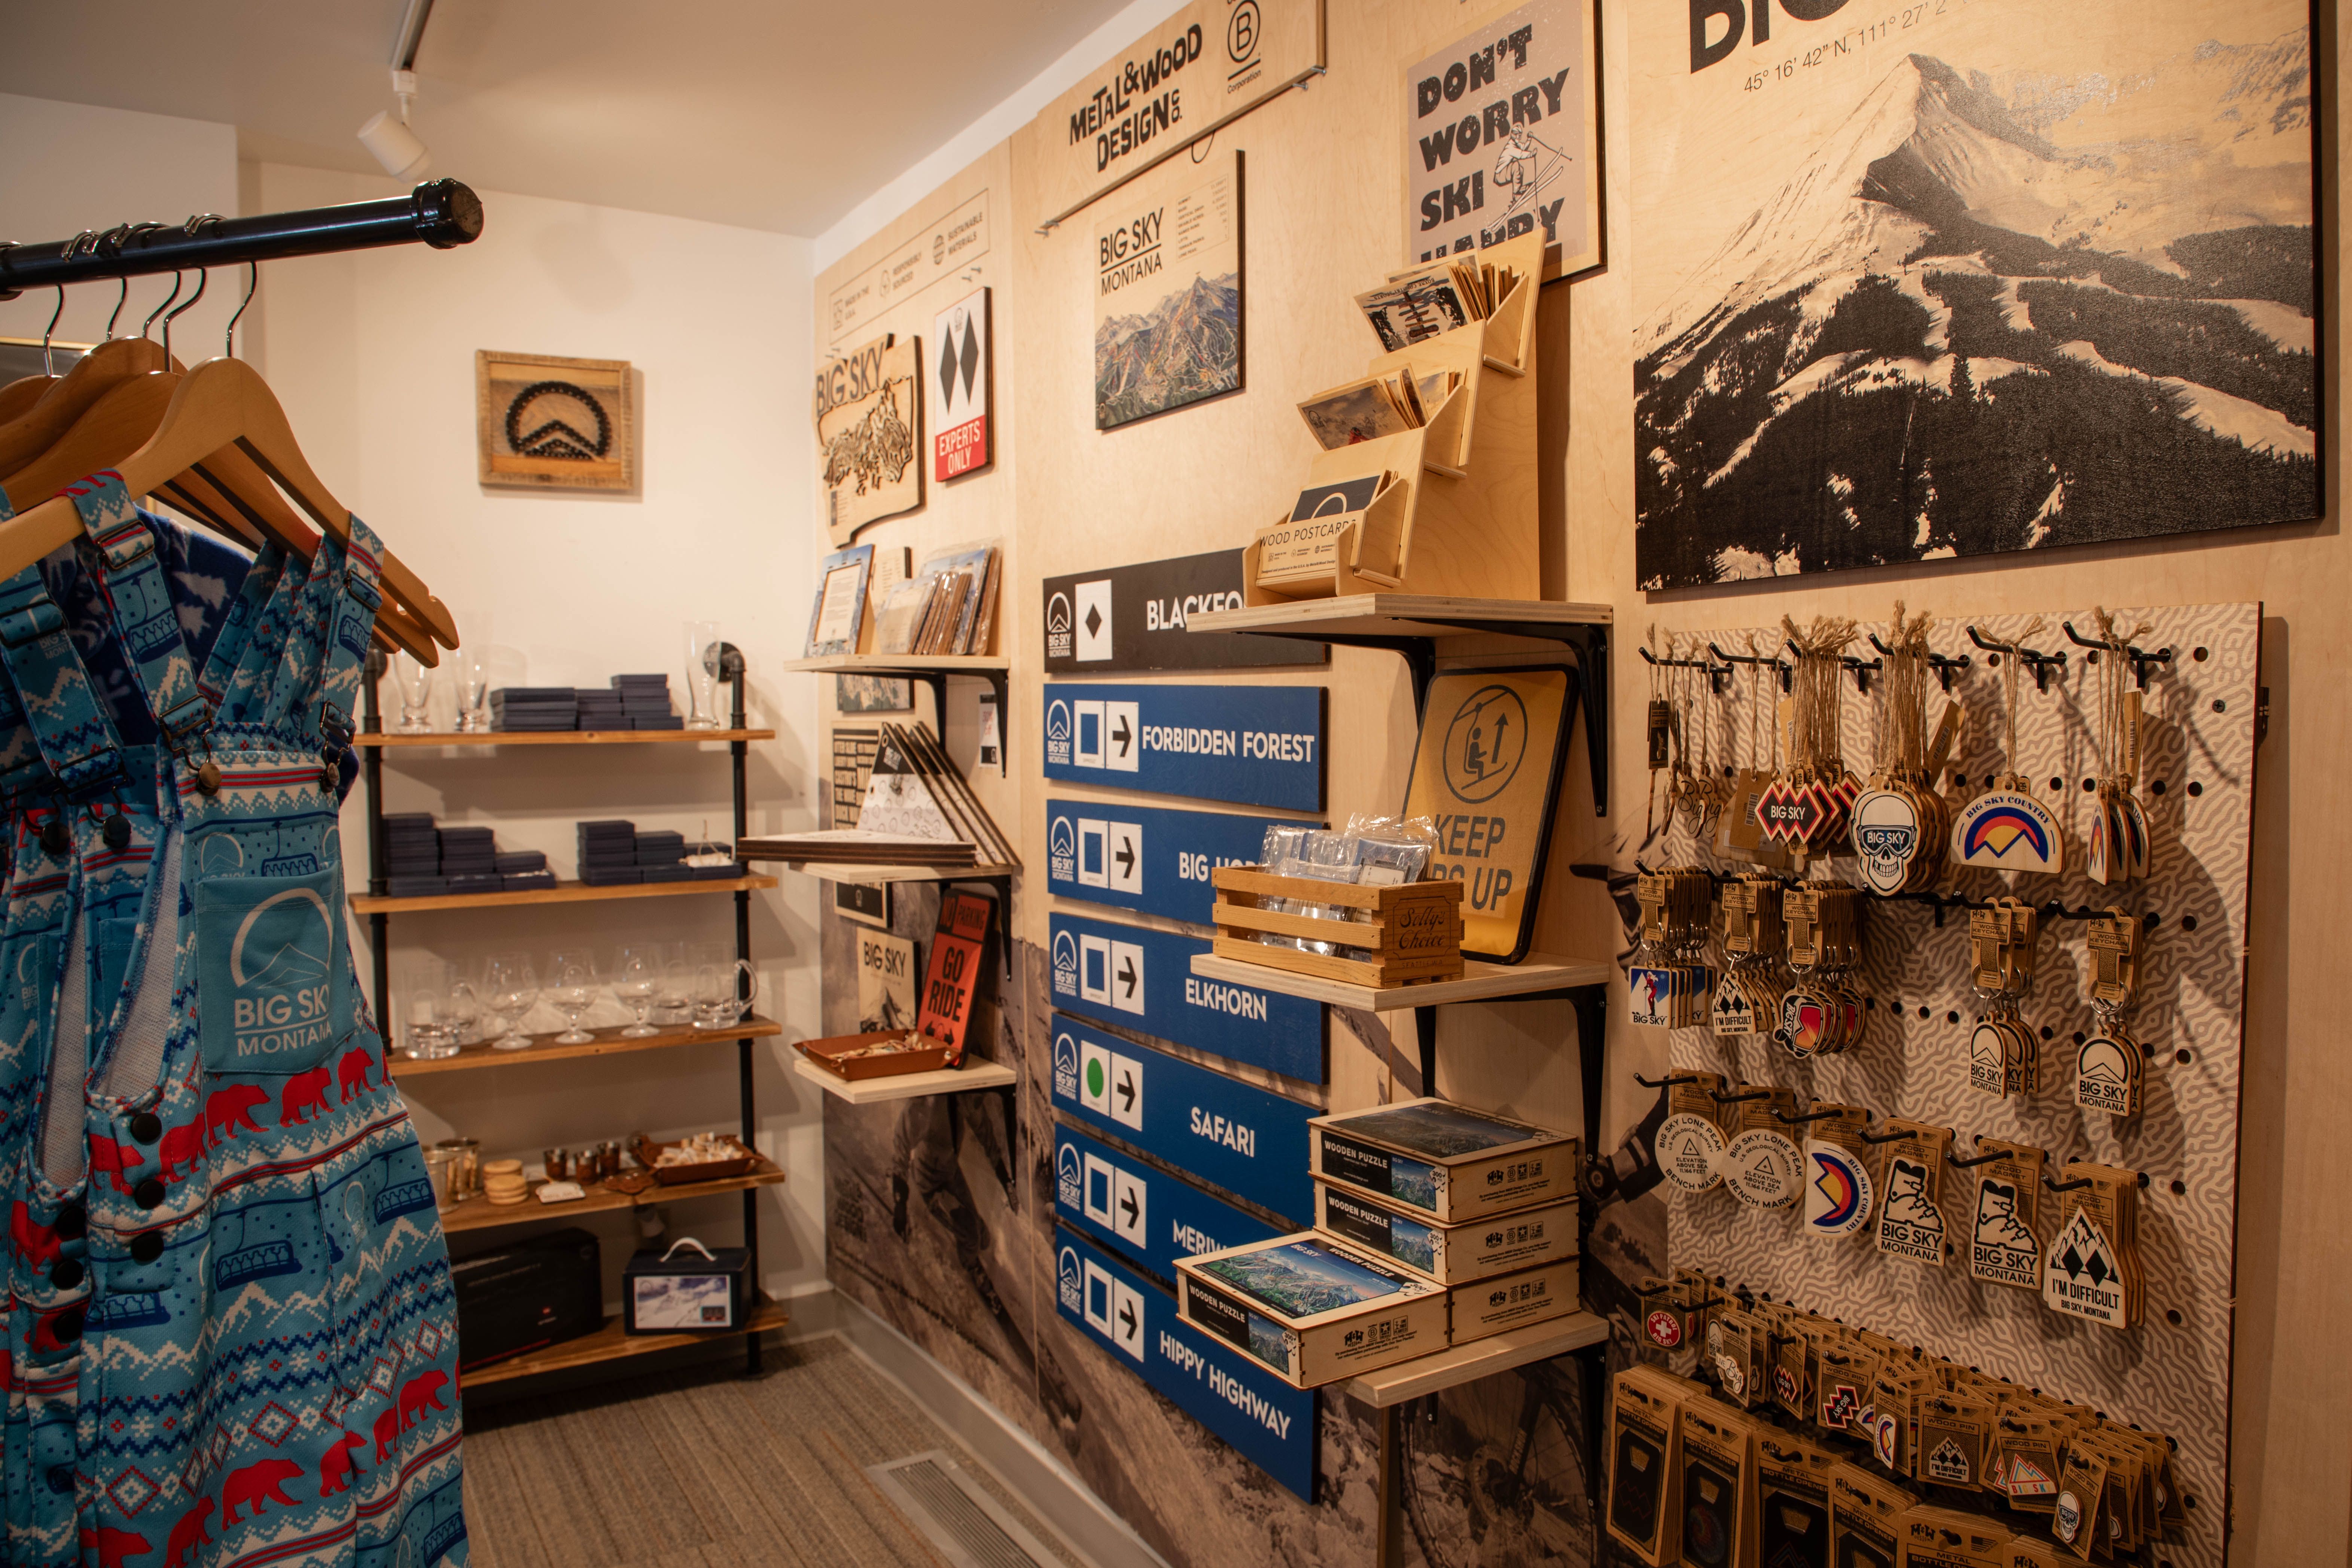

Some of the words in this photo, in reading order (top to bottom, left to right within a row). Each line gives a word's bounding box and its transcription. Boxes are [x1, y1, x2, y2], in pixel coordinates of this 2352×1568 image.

[1236, 12, 1252, 52] B
[1744, 70, 1769, 92] 45°
[1834, 39, 1851, 56] N,
[1858, 16, 1896, 46] 111°
[1227, 69, 1261, 94] Corporation
[1418, 24, 1532, 119] DON'T
[1097, 91, 1169, 173] DESIGN
[1419, 67, 1570, 173] WORRY
[1420, 170, 1484, 232] SKI
[1101, 228, 1127, 267] BIG
[1132, 207, 1163, 251] SKY
[1101, 252, 1162, 296] MONTANA
[1418, 278, 1435, 287] BOYNE
[816, 364, 846, 416] BIG
[850, 342, 883, 399] SKY
[939, 420, 980, 456] EXPERTS
[948, 447, 971, 474] ONLY
[1260, 532, 1290, 547] WOOD
[1294, 520, 1356, 541] POSTCARD
[1147, 591, 1246, 631] BLACKFO
[1048, 634, 1059, 646] BIG
[1060, 633, 1071, 646] SKY
[1048, 740, 1058, 752] BIG
[1058, 741, 1070, 753] SKY
[1142, 725, 1236, 756] FORBIDDEN
[1243, 731, 1314, 763] FOREST
[1771, 806, 1786, 818] BIG
[1788, 806, 1805, 820] SKY
[1966, 801, 1984, 819] BIG
[1984, 795, 2005, 808] SKY
[2007, 796, 2051, 825] COUNTRY
[1435, 814, 1506, 858] KEEP
[1867, 832, 1885, 844] BIG
[1886, 832, 1905, 844] SKY
[1052, 856, 1063, 869] BIG
[1063, 858, 1074, 871] SKY
[1179, 851, 1209, 882] BIG
[1471, 867, 1512, 911] UP
[956, 904, 986, 931] PARKING
[1399, 929, 1445, 950] Choice
[1972, 928, 2006, 937] KEYCHAIN
[2090, 938, 2128, 947] KEYCHAIN
[864, 941, 882, 970] BIG
[885, 947, 906, 978] SKY
[942, 946, 964, 983] GO
[1054, 969, 1065, 982] BIG
[1066, 972, 1077, 984] SKY
[234, 995, 292, 1028] BIG
[927, 980, 965, 1022] RIDE
[1185, 977, 1267, 1022] ELKHORN
[1725, 1015, 1752, 1026] DIFFICULT
[237, 1021, 332, 1057] MONTANA
[1055, 1070, 1066, 1085] BIG
[1066, 1075, 1077, 1090] SKY
[1971, 1063, 1984, 1078] BIG
[1987, 1067, 2003, 1083] SKY
[1971, 1080, 2001, 1096] MONTANA
[2079, 1080, 2101, 1096] BIG
[2103, 1084, 2127, 1101] SKY
[2079, 1096, 2125, 1113] MONTANA
[1190, 1106, 1255, 1157] SAFARI
[1666, 1118, 1679, 1133] SKY
[1682, 1118, 1705, 1129] LONE
[1706, 1127, 1722, 1152] PEAK
[1671, 1128, 1698, 1141] GEOLOGICAL
[1699, 1132, 1713, 1153] SURVEY
[1325, 1141, 1356, 1159] WOODEN
[1358, 1151, 1387, 1169] PUZZLE
[1730, 1144, 1741, 1158] BIG
[1742, 1133, 1761, 1145] SKY
[1764, 1134, 1791, 1151] LONE
[1789, 1150, 1802, 1177] PEAK
[1748, 1144, 1779, 1154] GEOLOGICAL
[1780, 1154, 1791, 1176] SURVEY
[1666, 1168, 1695, 1190] BENCH
[1698, 1172, 1721, 1190] MARK
[1743, 1176, 1765, 1186] ABOVE
[1745, 1170, 1781, 1185] ELEVATION
[1728, 1178, 1759, 1206] BENCH
[1763, 1195, 1792, 1209] MARK
[1329, 1196, 1358, 1216] WOODEN
[1361, 1210, 1388, 1228] PUZZLE
[1882, 1223, 1909, 1241] BIG
[1911, 1229, 1943, 1249] SKY
[1329, 1248, 1364, 1263] WOODEN
[1362, 1262, 1395, 1277] PUZZLE
[1881, 1240, 1939, 1263] MONTANA
[1974, 1246, 2002, 1264] BIG
[2006, 1254, 2038, 1271] SKY
[1975, 1266, 2035, 1286] MONTANA
[1189, 1285, 1217, 1307] WOODEN
[1219, 1301, 1246, 1323] PUZZLE
[2070, 1282, 2119, 1310] DIFFICULT
[1650, 1314, 1659, 1323] SKI
[1660, 1313, 1677, 1330] PATROL
[1285, 1332, 1293, 1341] 300
[1160, 1330, 1205, 1380] HIPPY
[1209, 1364, 1291, 1440] HIGHWAY
[1716, 1357, 1725, 1367] LIVE
[1726, 1359, 1742, 1391] Big
[1618, 1408, 1641, 1422] BOTTLE
[1642, 1419, 1665, 1435] OPENER
[1633, 1407, 1651, 1421] METAL
[1685, 1438, 1710, 1454] BOTTLE
[1711, 1450, 1736, 1467] OPENER
[1701, 1438, 1721, 1452] METAL
[1941, 1465, 1967, 1476] DIFFICULT
